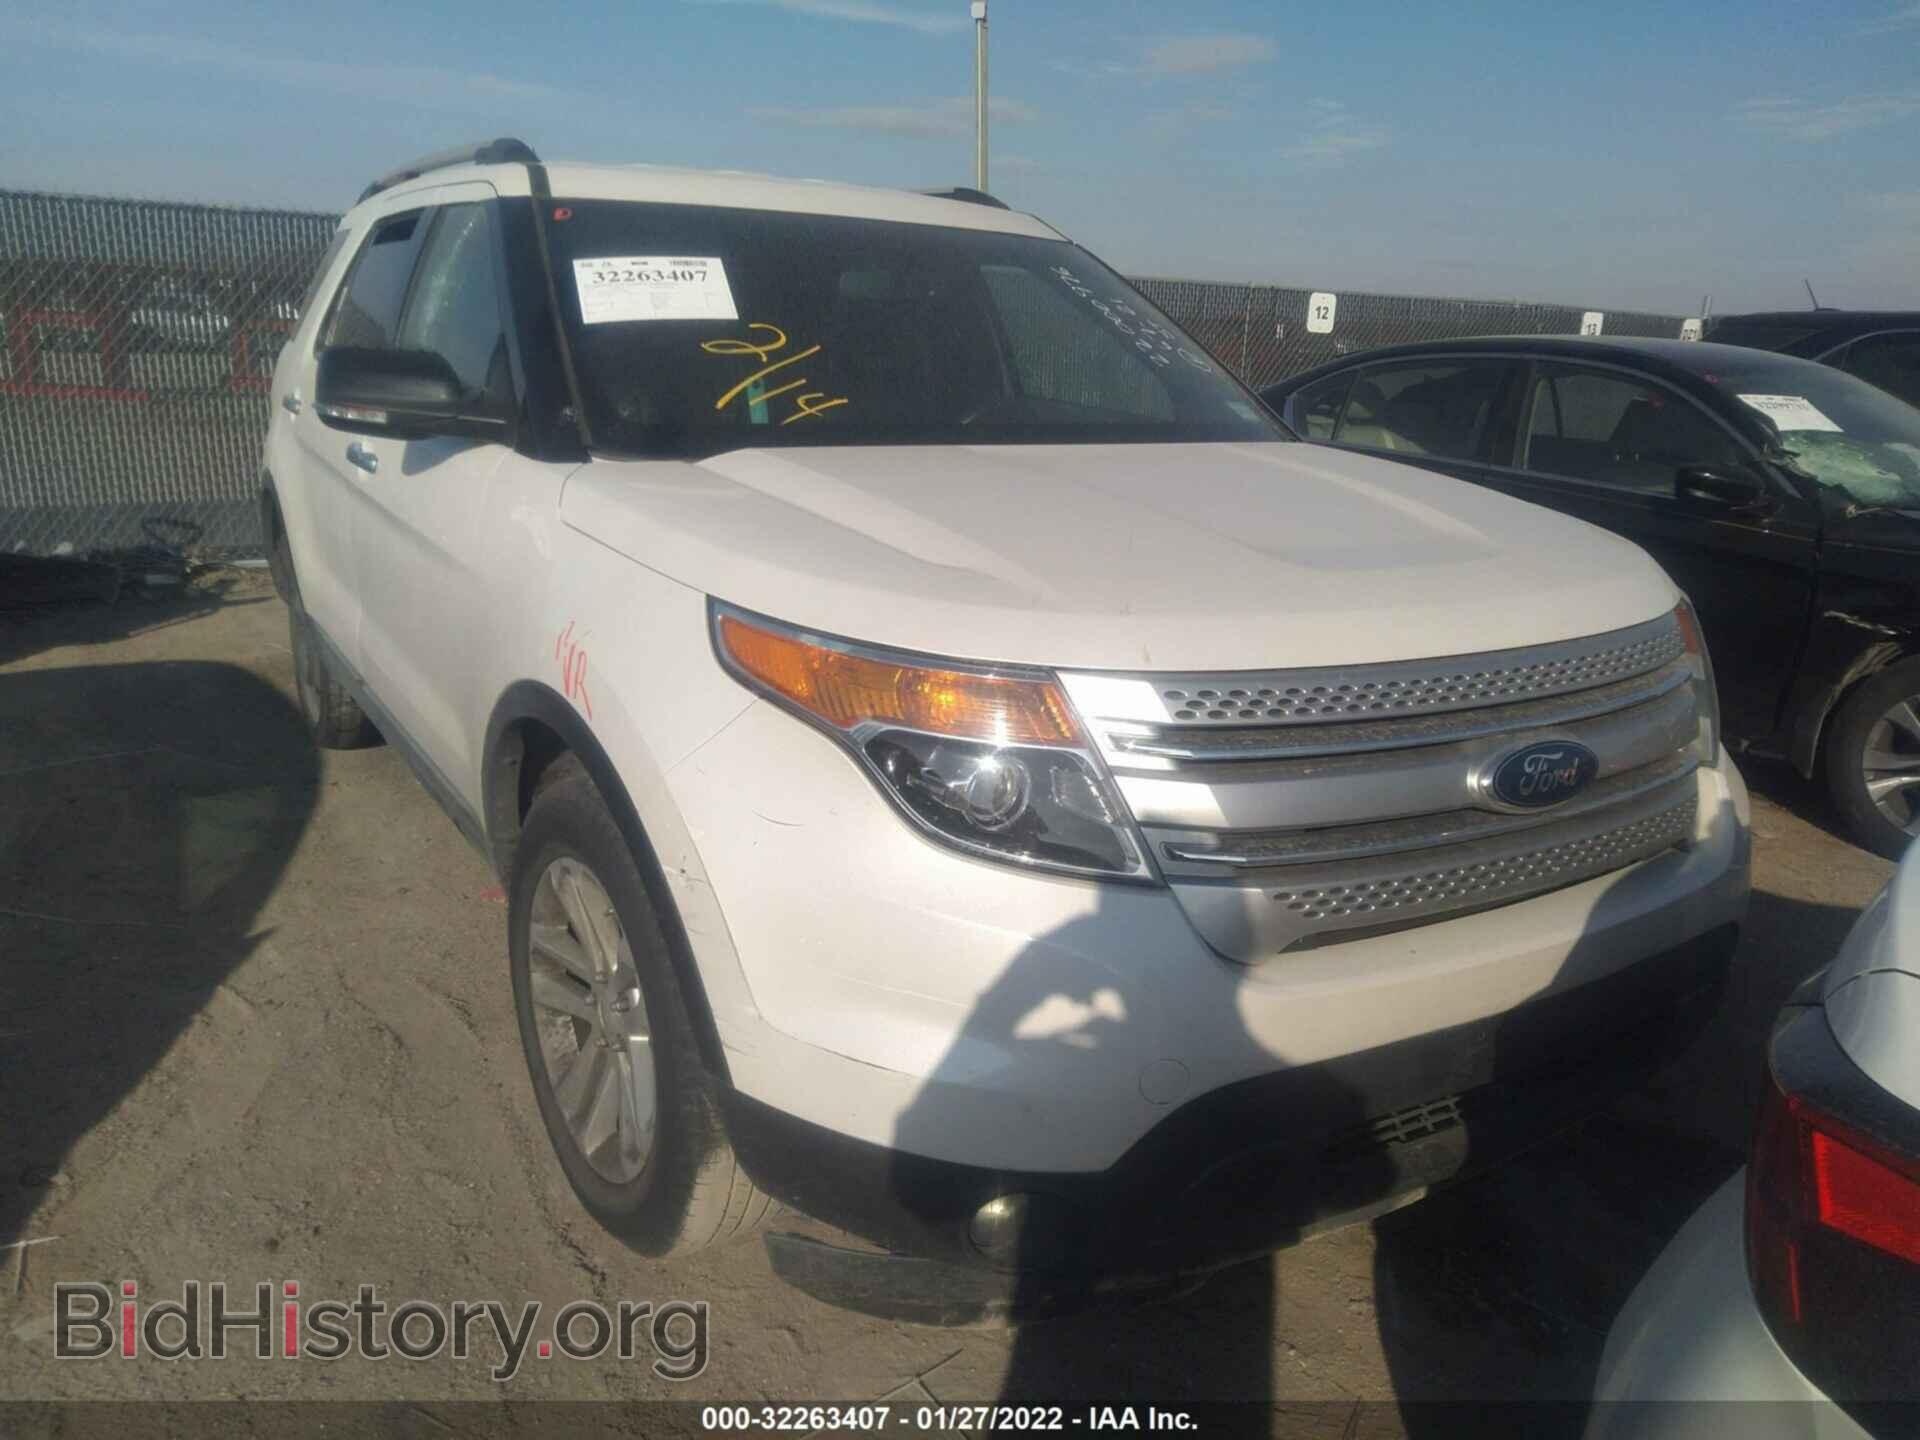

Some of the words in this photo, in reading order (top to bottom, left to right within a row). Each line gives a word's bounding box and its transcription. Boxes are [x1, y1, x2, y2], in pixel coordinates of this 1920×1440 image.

[593, 270, 707, 284] 32263407
[1315, 305, 1329, 320] 12
[1519, 751, 1580, 796] Ford
